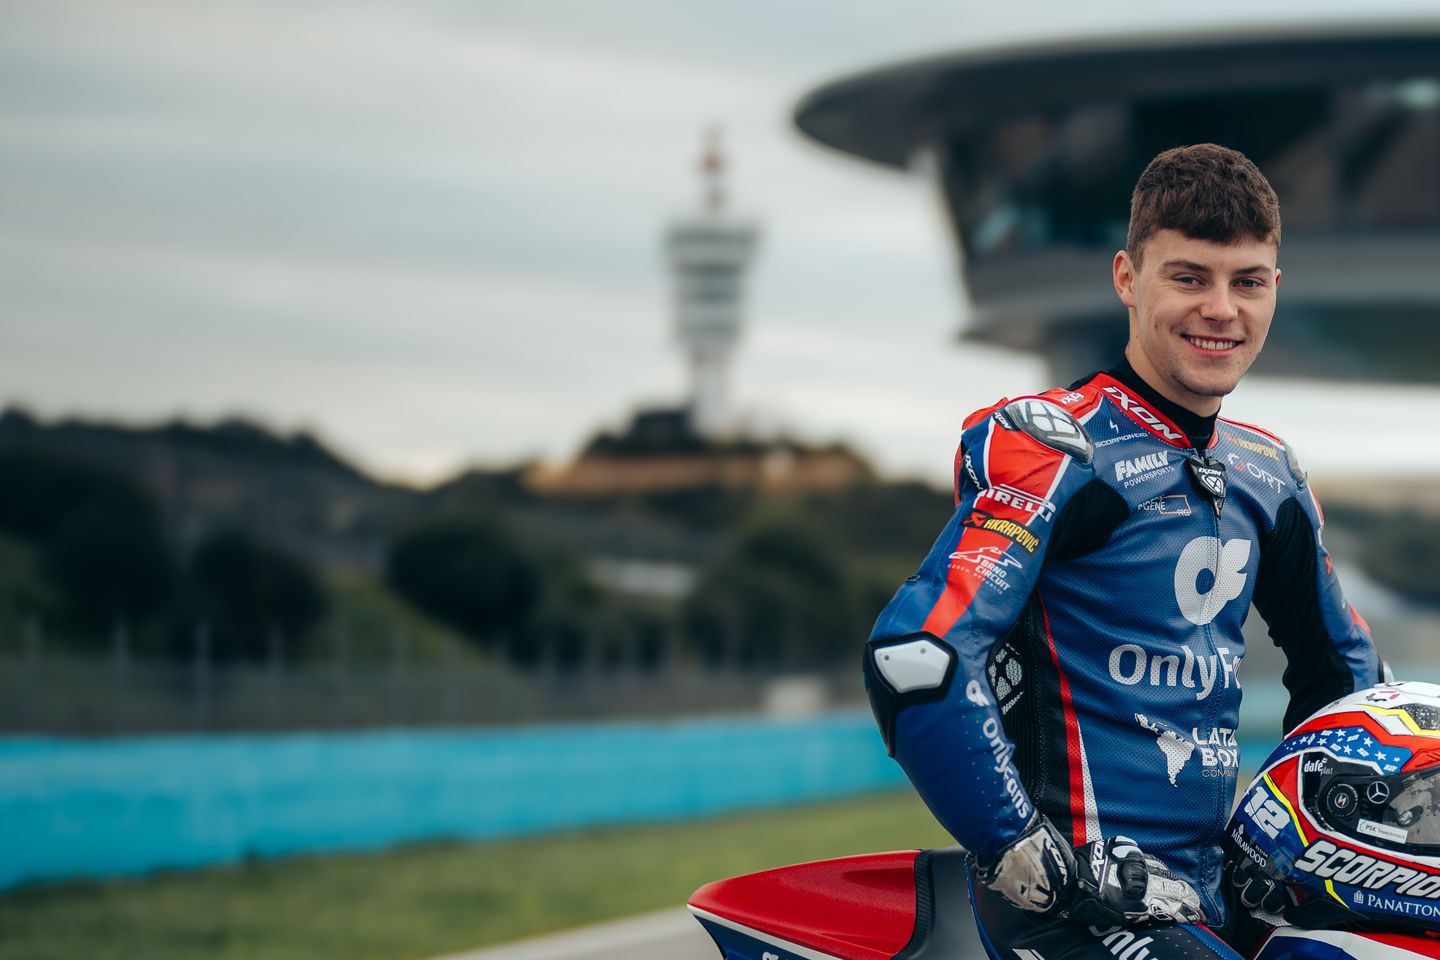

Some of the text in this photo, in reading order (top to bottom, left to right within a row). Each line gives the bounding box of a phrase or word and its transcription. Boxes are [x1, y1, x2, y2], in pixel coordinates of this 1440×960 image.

[1102, 386, 1183, 440] IXON
[1114, 450, 1169, 482] FAMILY
[1124, 466, 1176, 489] POWERSPORTS
[975, 564, 1010, 590] CIRCUIT
[981, 558, 1008, 580] BRNO
[1243, 786, 1291, 840] 12
